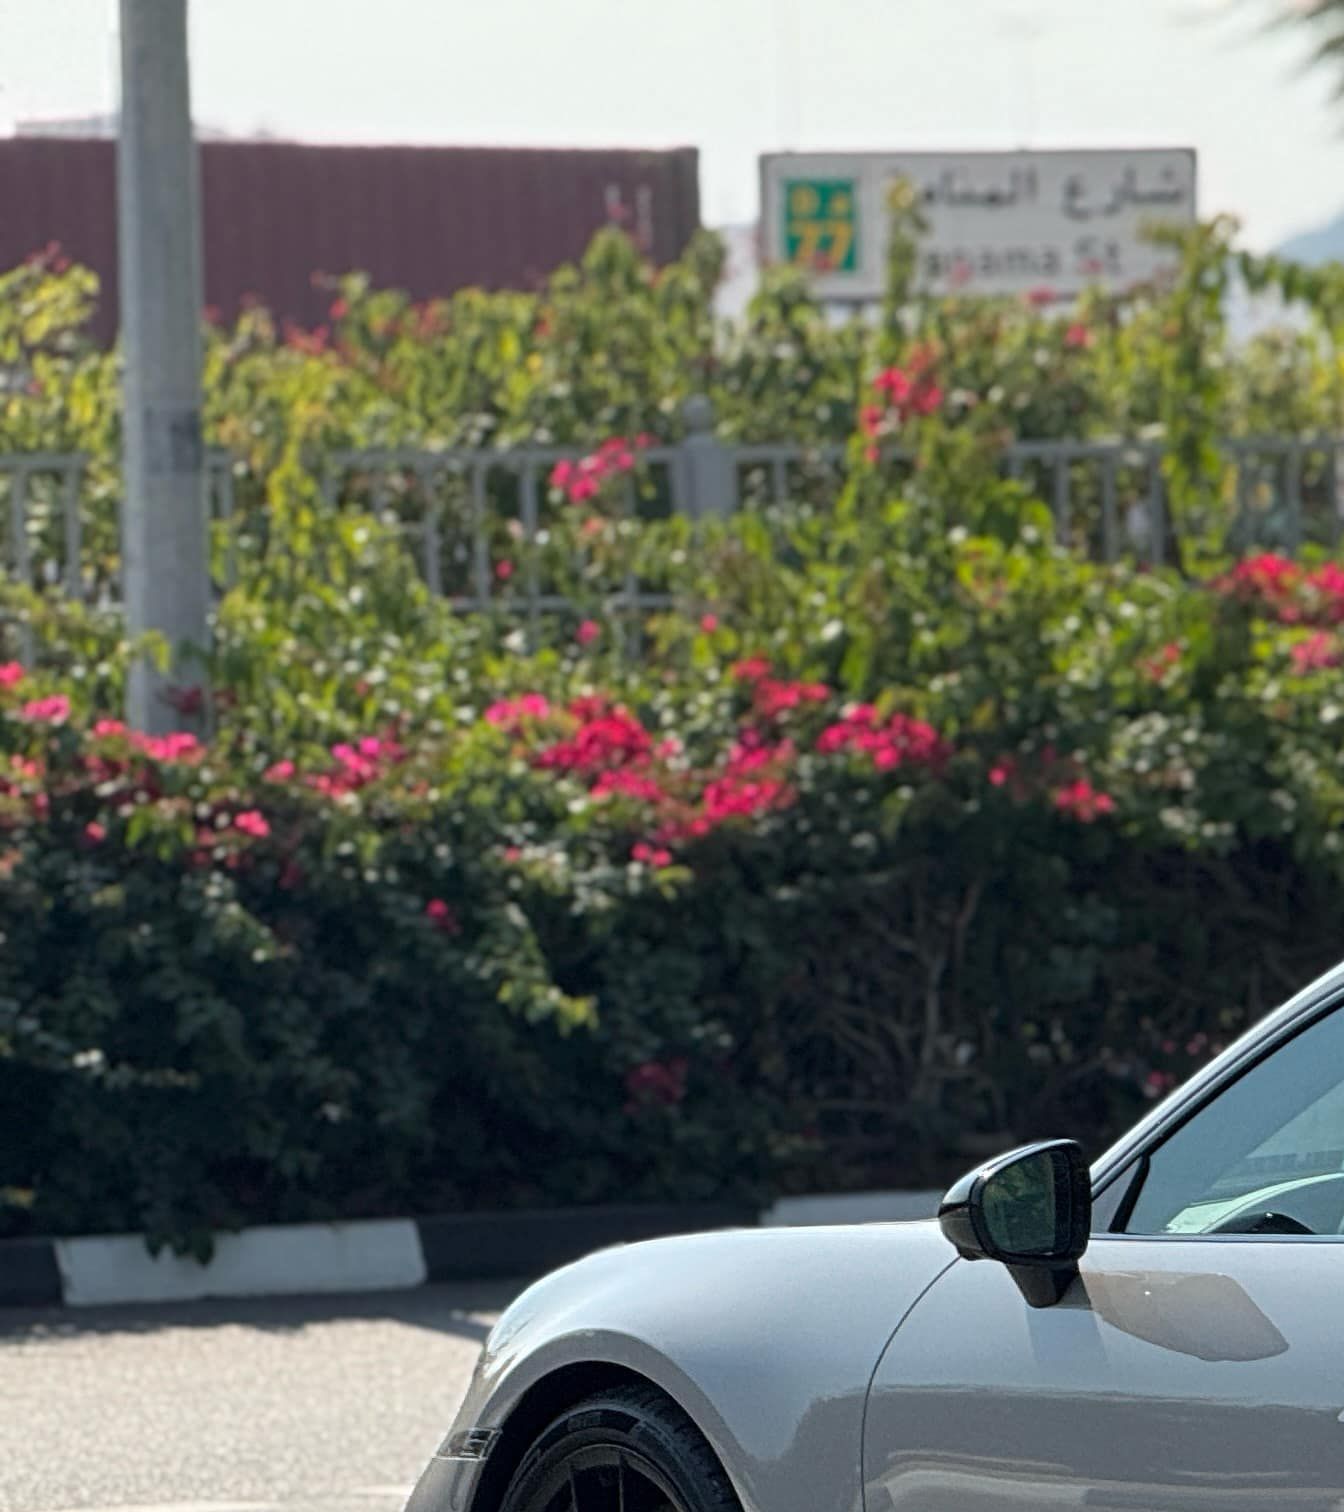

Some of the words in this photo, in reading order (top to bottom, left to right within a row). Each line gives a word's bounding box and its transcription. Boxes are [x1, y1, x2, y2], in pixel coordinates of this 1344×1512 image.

[921, 165, 1038, 207] المنام
[1063, 165, 1185, 222] شارع
[925, 244, 1061, 278] anama
